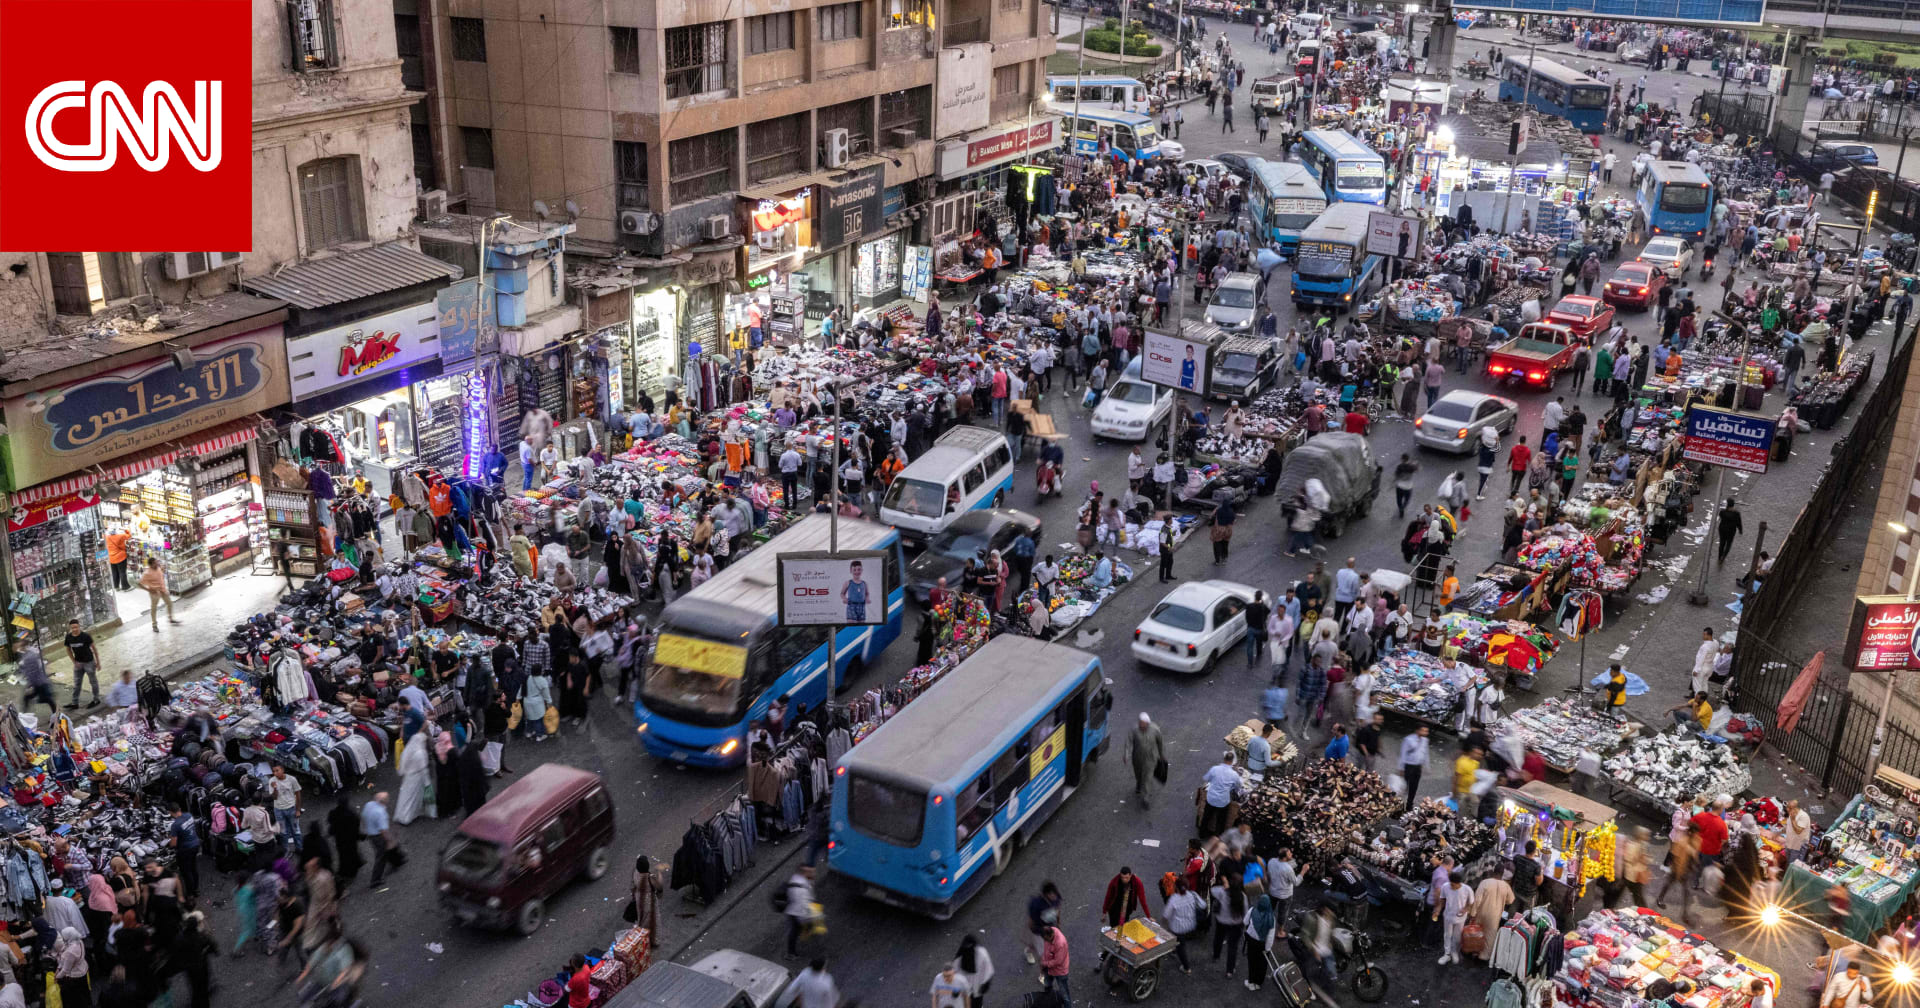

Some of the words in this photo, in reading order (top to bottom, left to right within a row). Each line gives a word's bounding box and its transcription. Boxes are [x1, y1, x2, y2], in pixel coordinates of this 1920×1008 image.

[980, 143, 1000, 156] BANQUE
[1000, 138, 1013, 151] MISR
[844, 212, 862, 234] BTC
[337, 329, 401, 376] Mix
[1149, 352, 1173, 364] Ots
[66, 351, 246, 446] الأندلس
[1695, 418, 1767, 439] تساهيل
[793, 587, 830, 597] Ots
